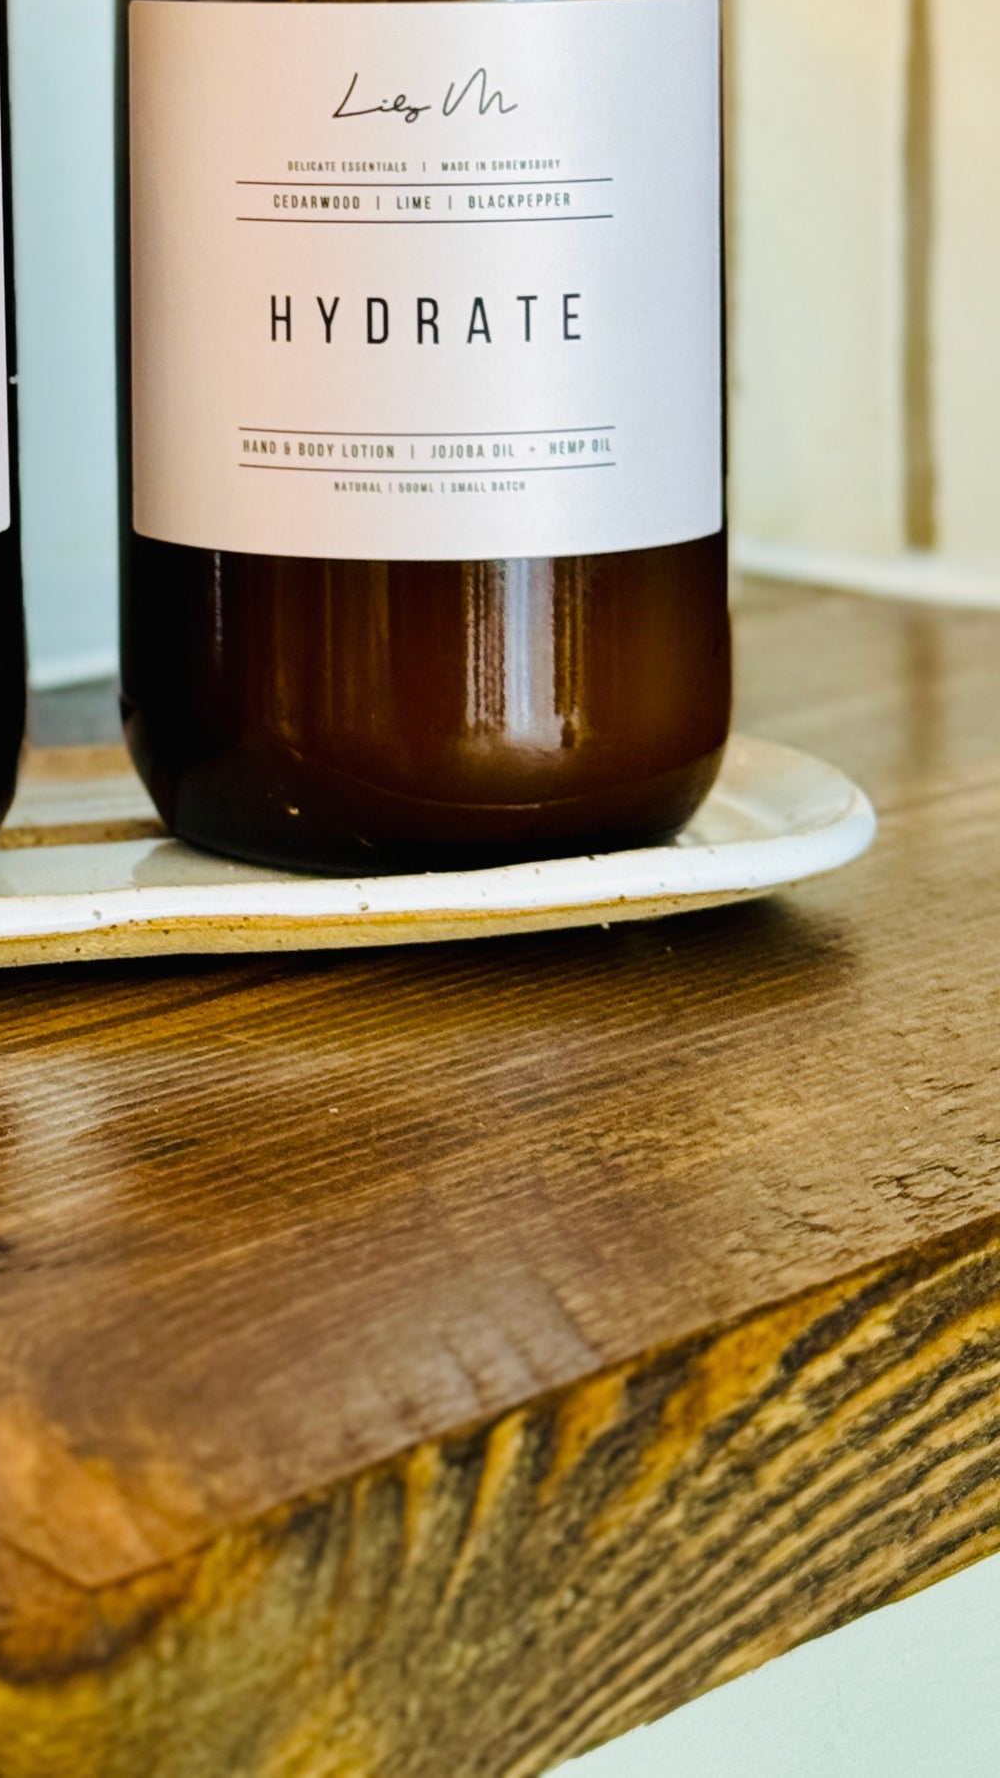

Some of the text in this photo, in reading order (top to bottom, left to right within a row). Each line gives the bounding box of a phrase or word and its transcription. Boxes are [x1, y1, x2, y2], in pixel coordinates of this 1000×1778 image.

[287, 160, 337, 173] DELICATE
[341, 160, 408, 173] ESSENTIALS
[440, 160, 470, 172] MADE
[475, 160, 487, 172] IN
[491, 158, 561, 172] SHREWSBURY
[273, 193, 361, 210] CEDARWOOD
[396, 195, 431, 211] LIME
[467, 192, 571, 210] BLACKPEPPER
[270, 292, 582, 345] HYDRATE
[242, 439, 277, 455] HAND
[283, 441, 292, 456] &
[297, 441, 335, 458] BODY
[341, 443, 395, 460] LOTION
[430, 443, 486, 460] JOJOBA
[492, 442, 515, 459] OIL
[548, 439, 586, 456] HEMP
[591, 437, 612, 454] OIL
[333, 480, 383, 494] NATURAL
[397, 481, 434, 494] 500ML
[450, 481, 487, 494] SMALL
[490, 480, 526, 493] BATCH
